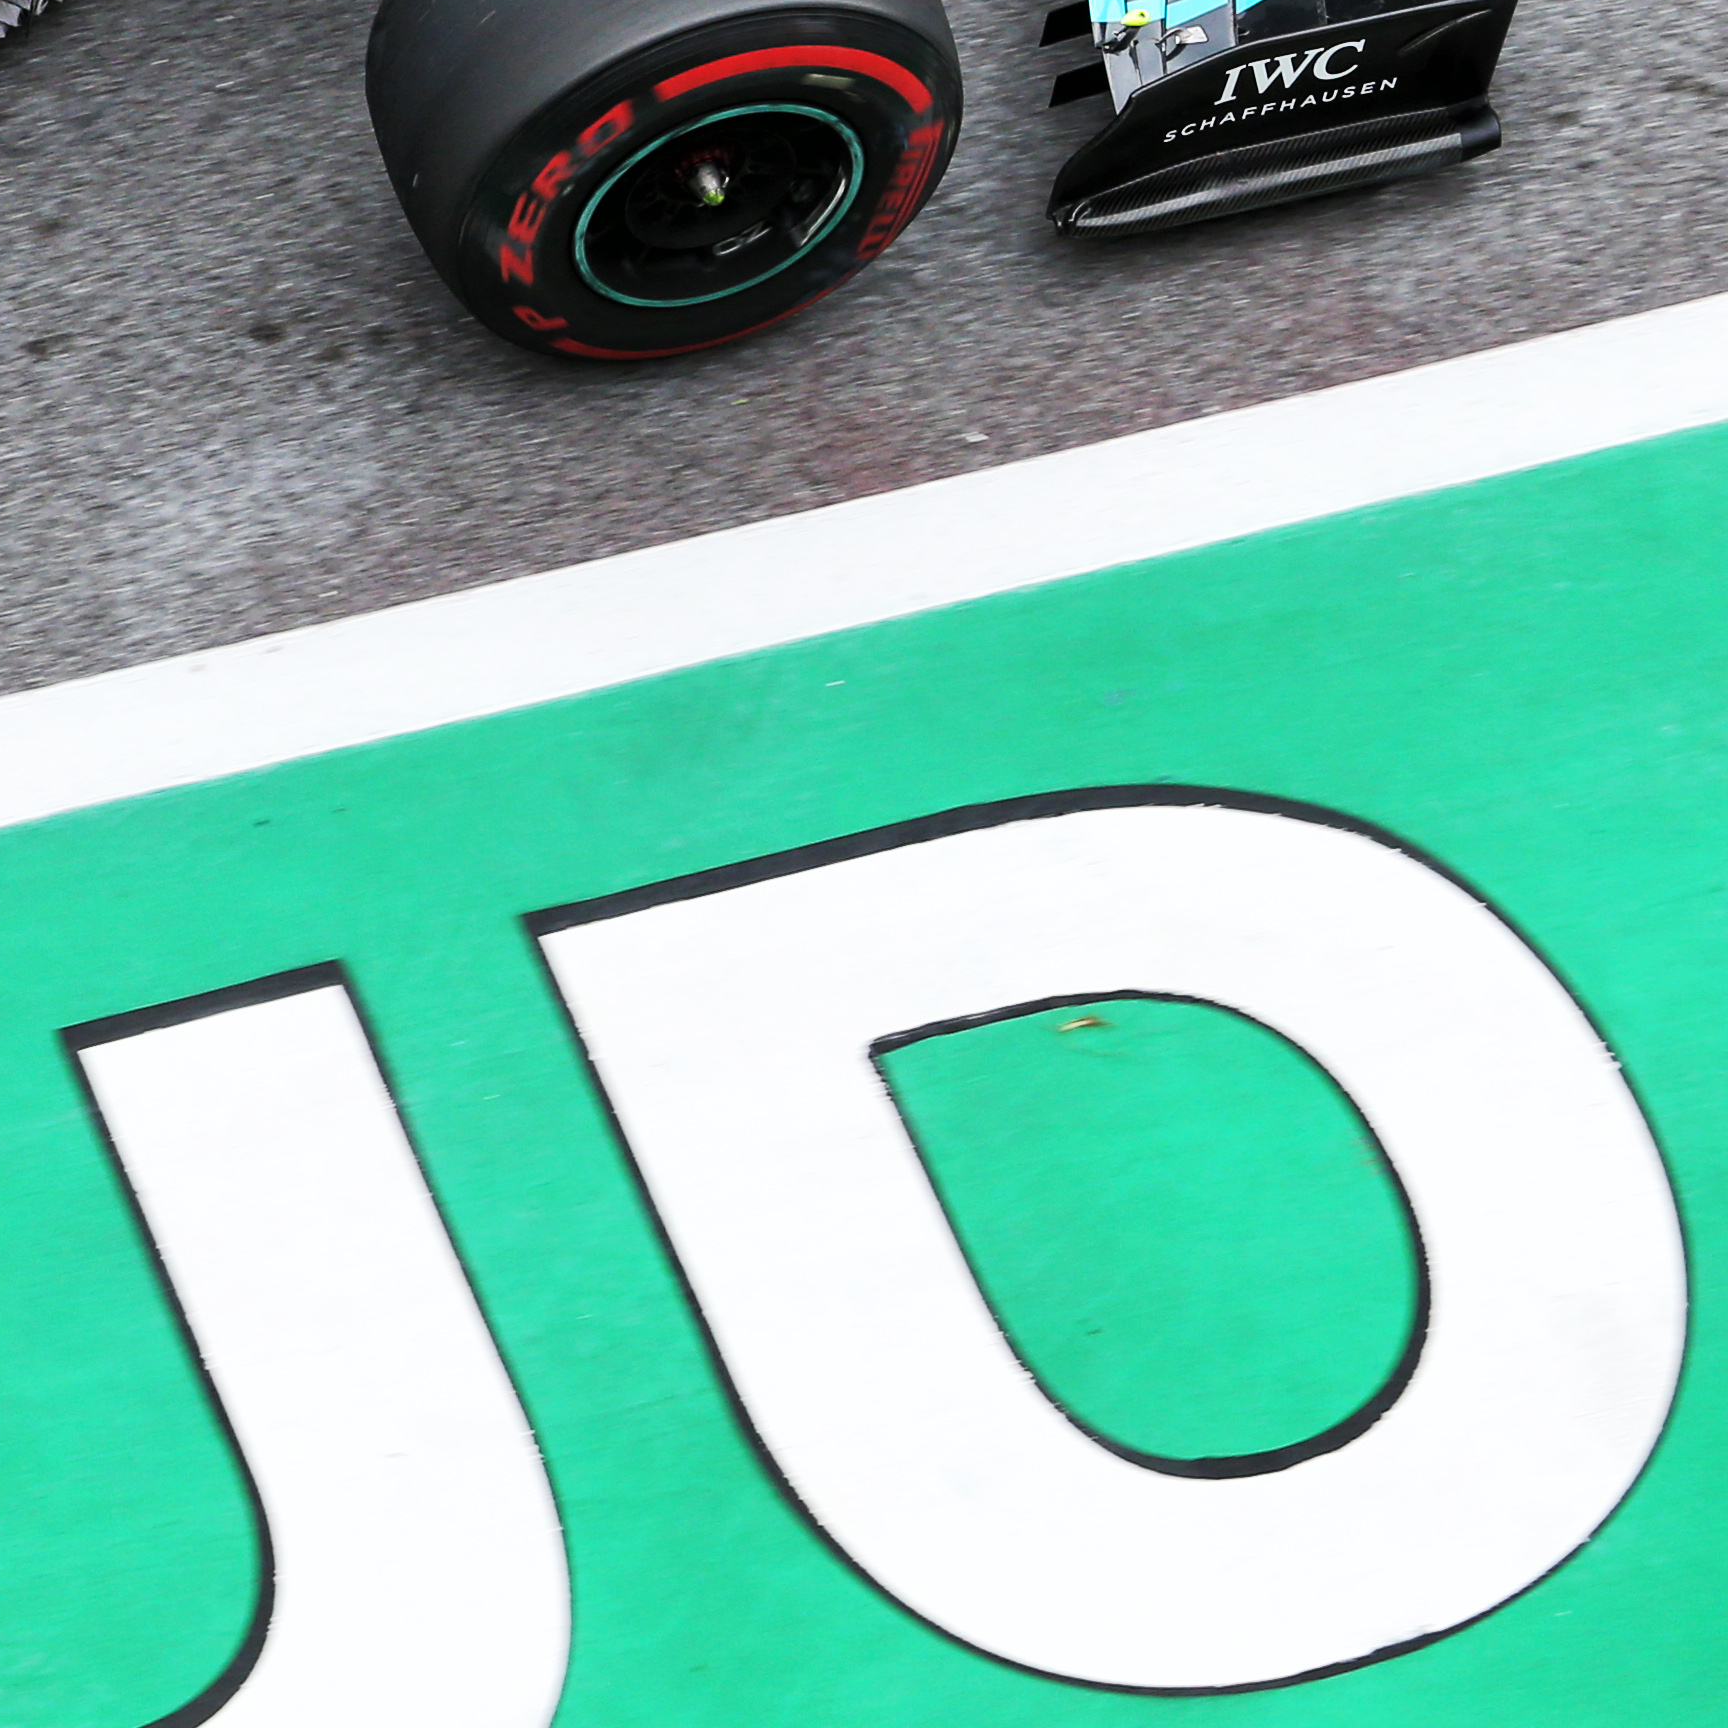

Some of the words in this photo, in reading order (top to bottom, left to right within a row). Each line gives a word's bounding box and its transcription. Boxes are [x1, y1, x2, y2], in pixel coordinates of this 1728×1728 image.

[1213, 38, 1366, 107] IWC
[1163, 76, 1399, 143] SCHAFFHAUSEN
[501, 100, 635, 284] ZERO
[513, 303, 569, 331] P
